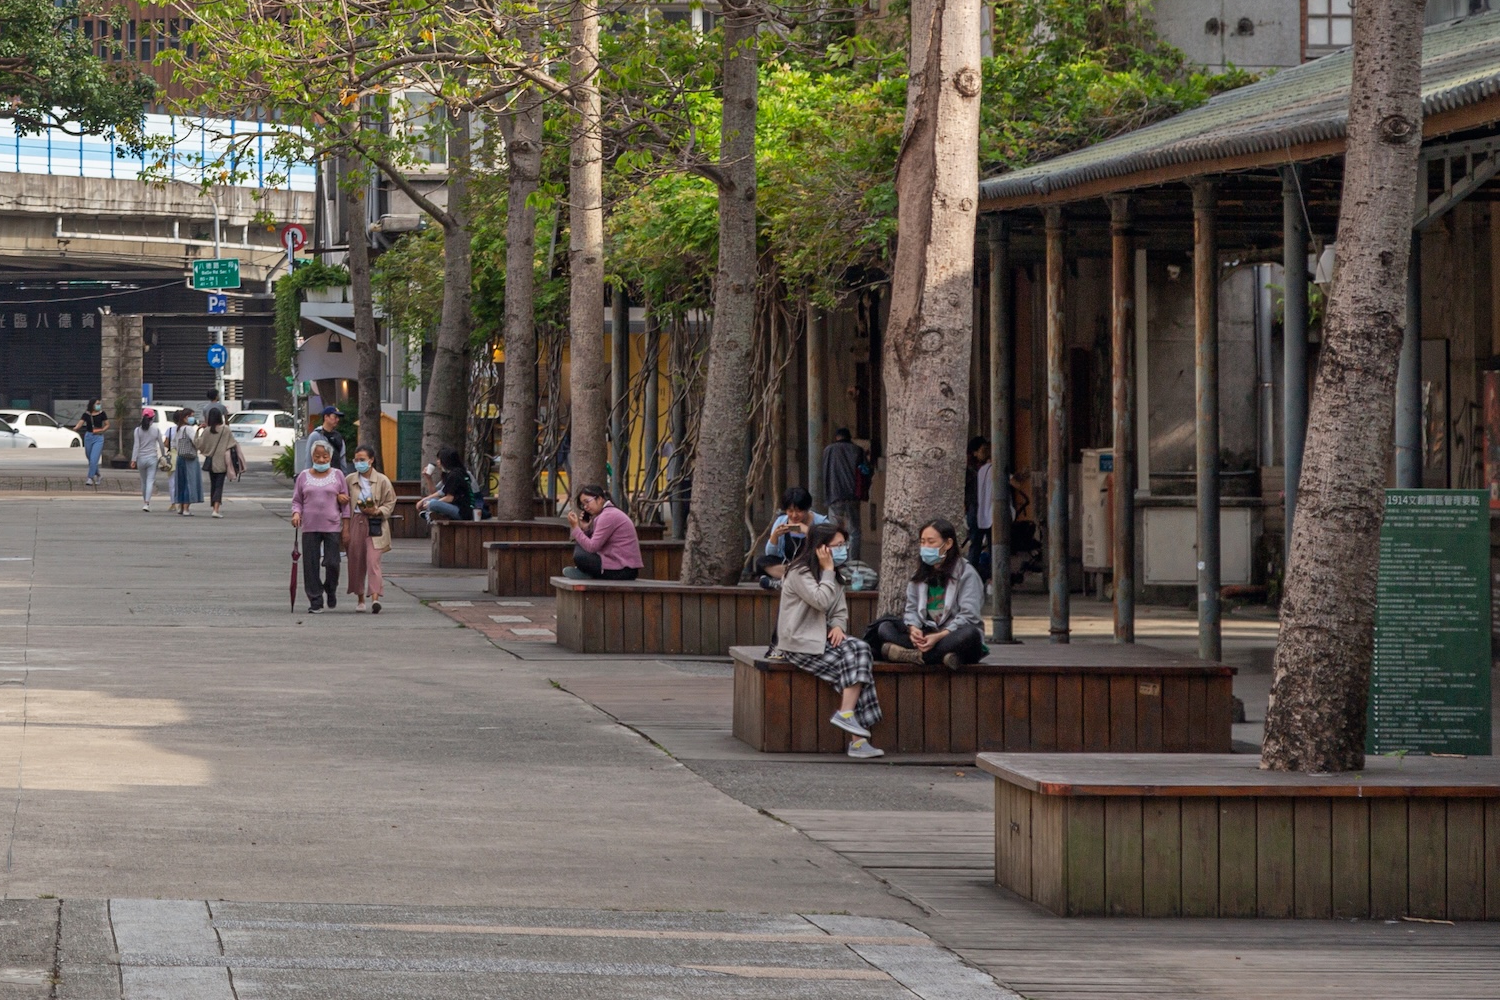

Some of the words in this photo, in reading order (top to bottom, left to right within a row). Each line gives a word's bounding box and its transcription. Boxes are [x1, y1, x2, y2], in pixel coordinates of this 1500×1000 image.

[209, 296, 218, 311] P
[1384, 495, 1480, 506] 1914文創園區管理要點
